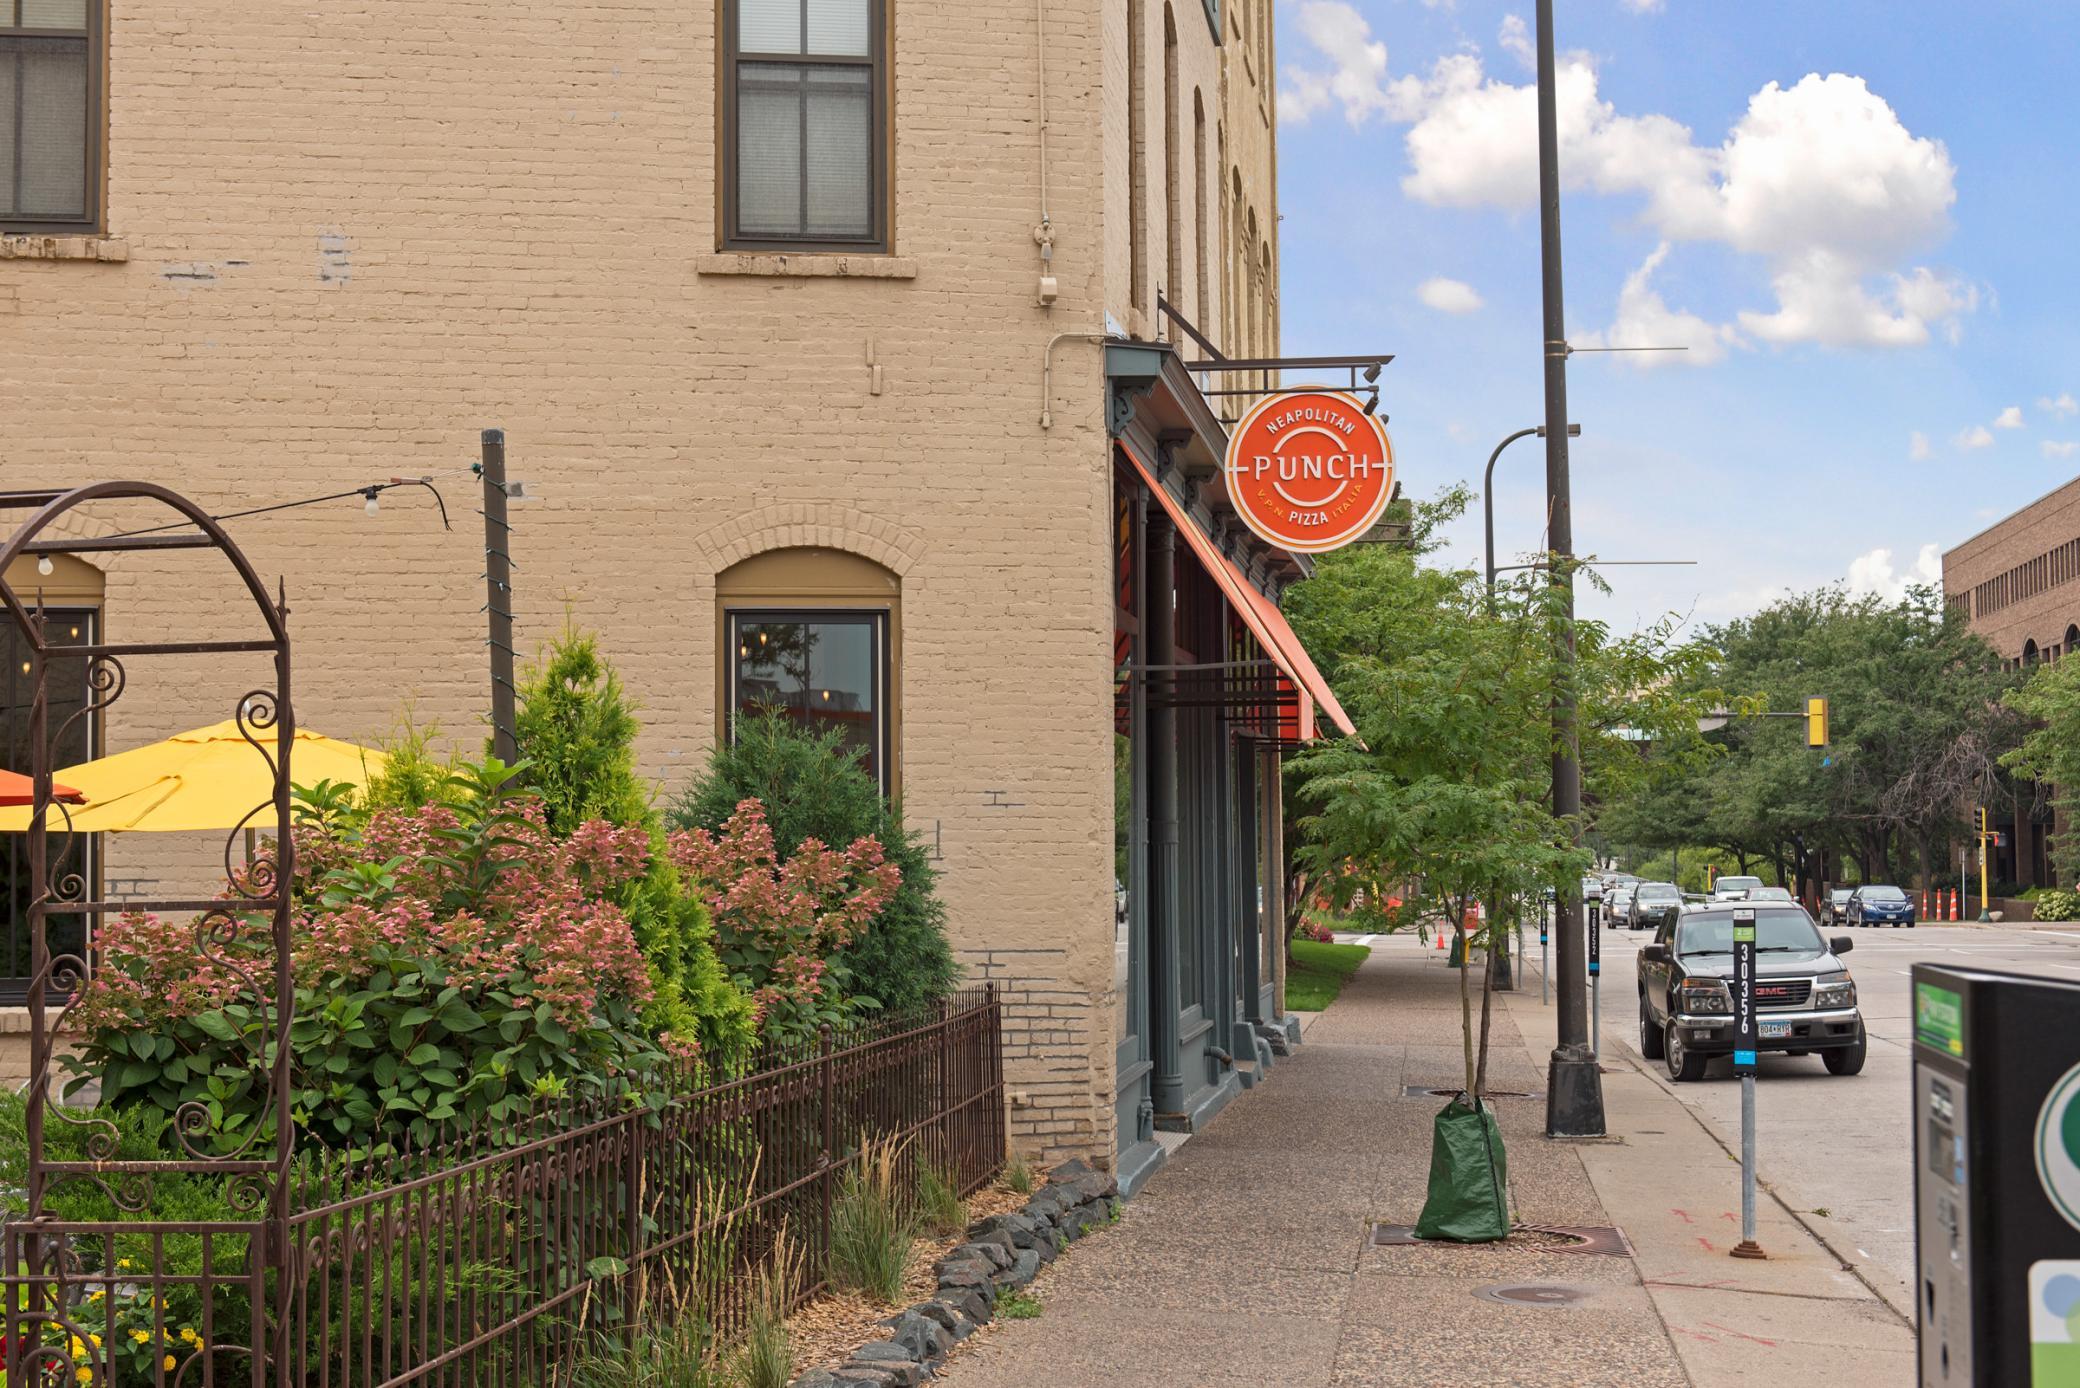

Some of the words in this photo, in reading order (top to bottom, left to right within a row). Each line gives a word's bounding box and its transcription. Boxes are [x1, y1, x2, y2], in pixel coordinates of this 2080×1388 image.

[1266, 408, 1356, 434] NEAPOLITAN
[1253, 454, 1368, 480] PUNCH
[1288, 511, 1329, 526] PIZZA
[1332, 484, 1363, 518] ITALIA
[1741, 944, 1749, 1034] 30356
[1755, 987, 1787, 996] GMC
